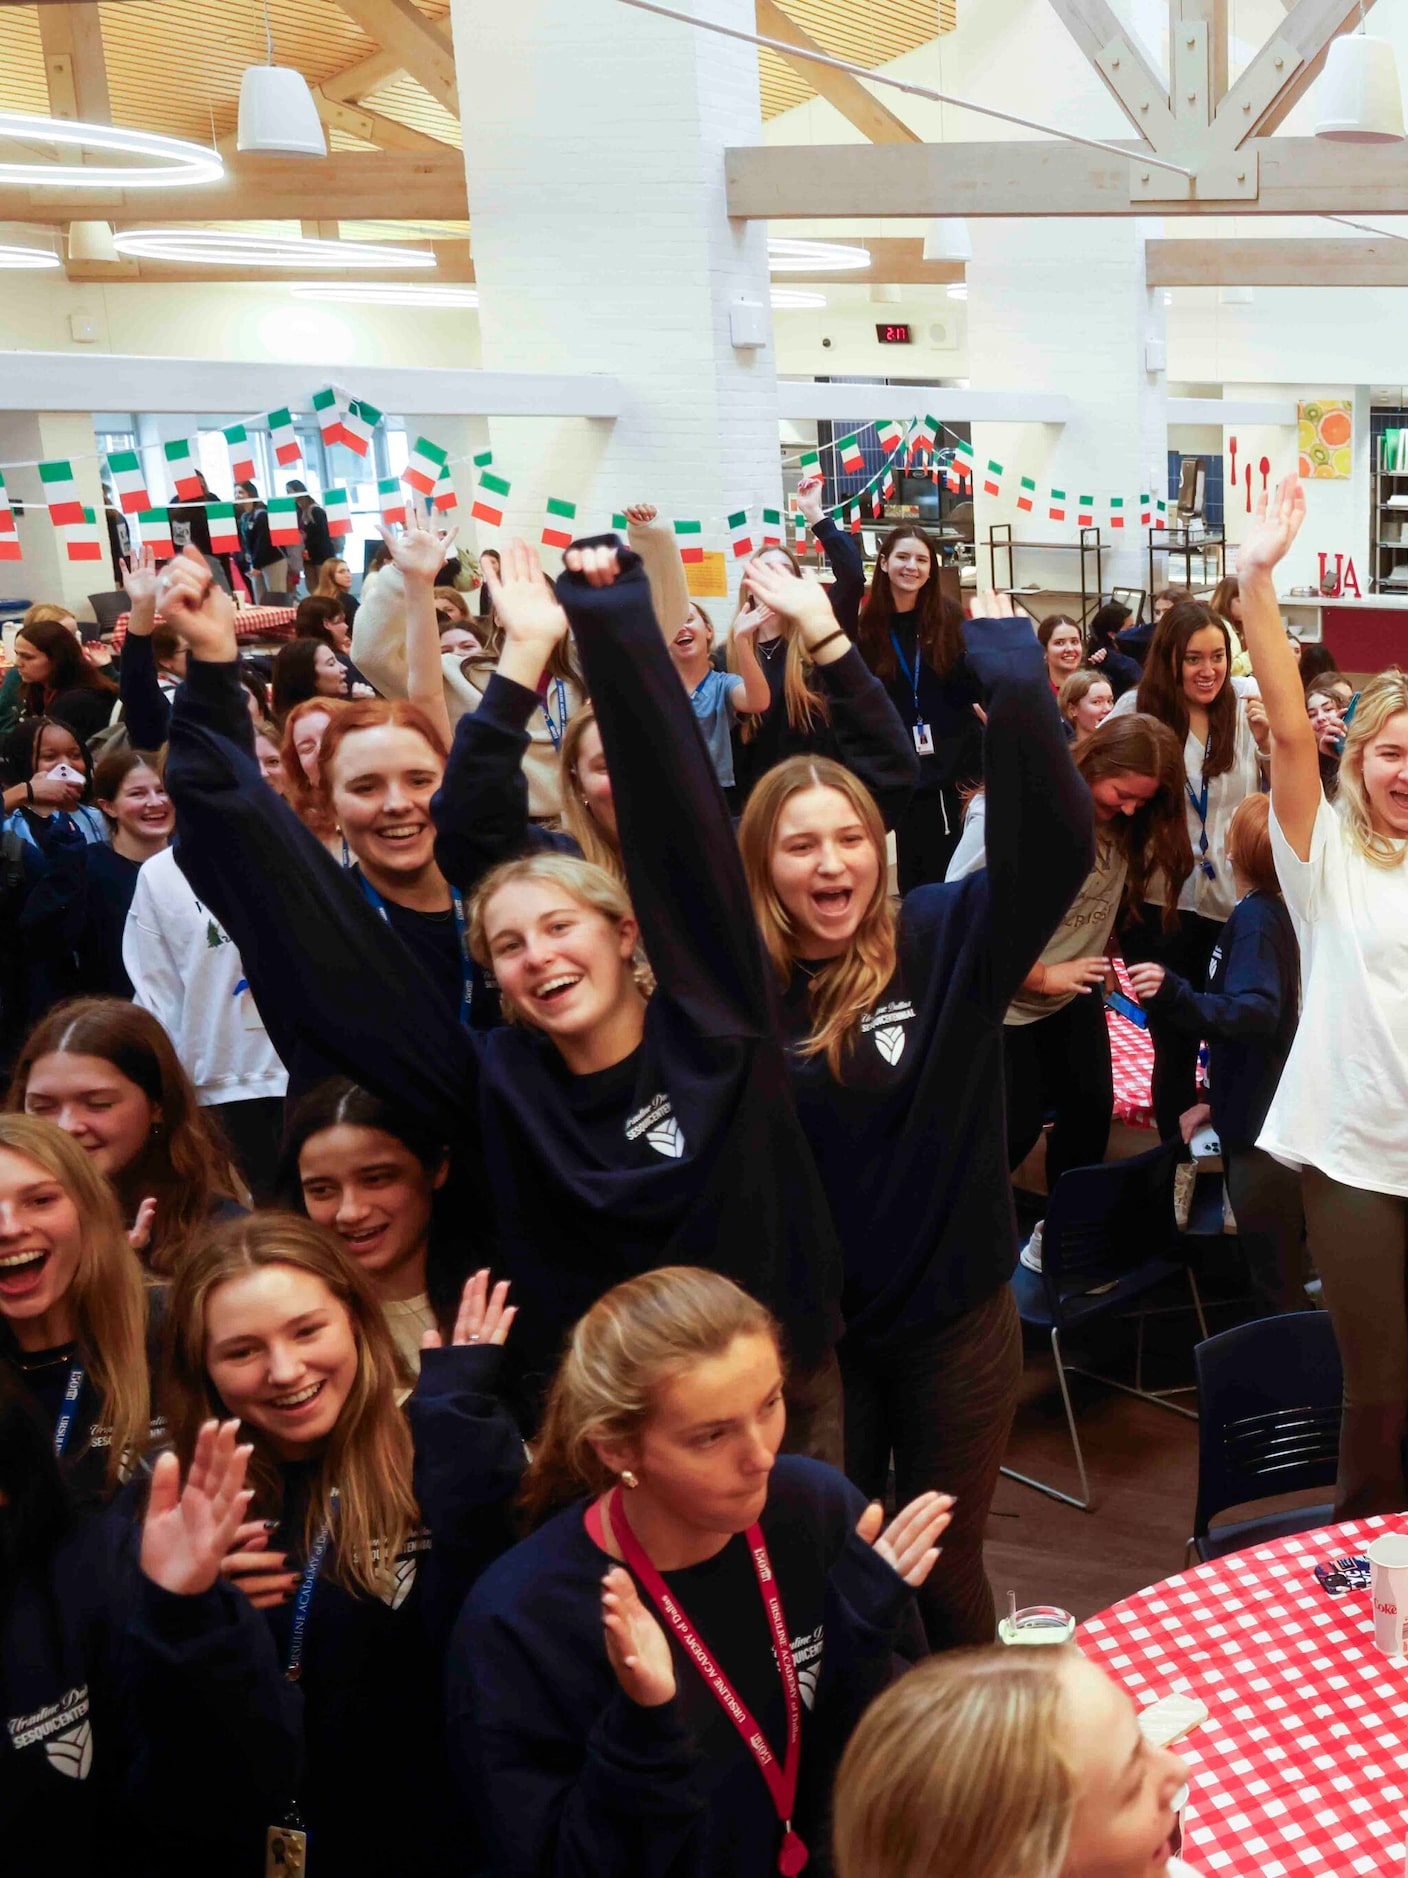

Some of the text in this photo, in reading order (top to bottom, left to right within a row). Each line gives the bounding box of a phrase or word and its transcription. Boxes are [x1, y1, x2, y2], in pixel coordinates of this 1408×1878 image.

[1317, 552, 1361, 598] UA
[298, 1556, 321, 1612] ACADEMY
[316, 1545, 323, 1556] of
[1374, 1598, 1397, 1615] Coke
[661, 1594, 746, 1724] URSULINE ACADEMY of Dallas
[769, 1598, 788, 1647] URSULINE
[782, 1649, 798, 1699] ACADEMY
[791, 1702, 798, 1711] of
[7, 1703, 60, 1735] Ursuline
